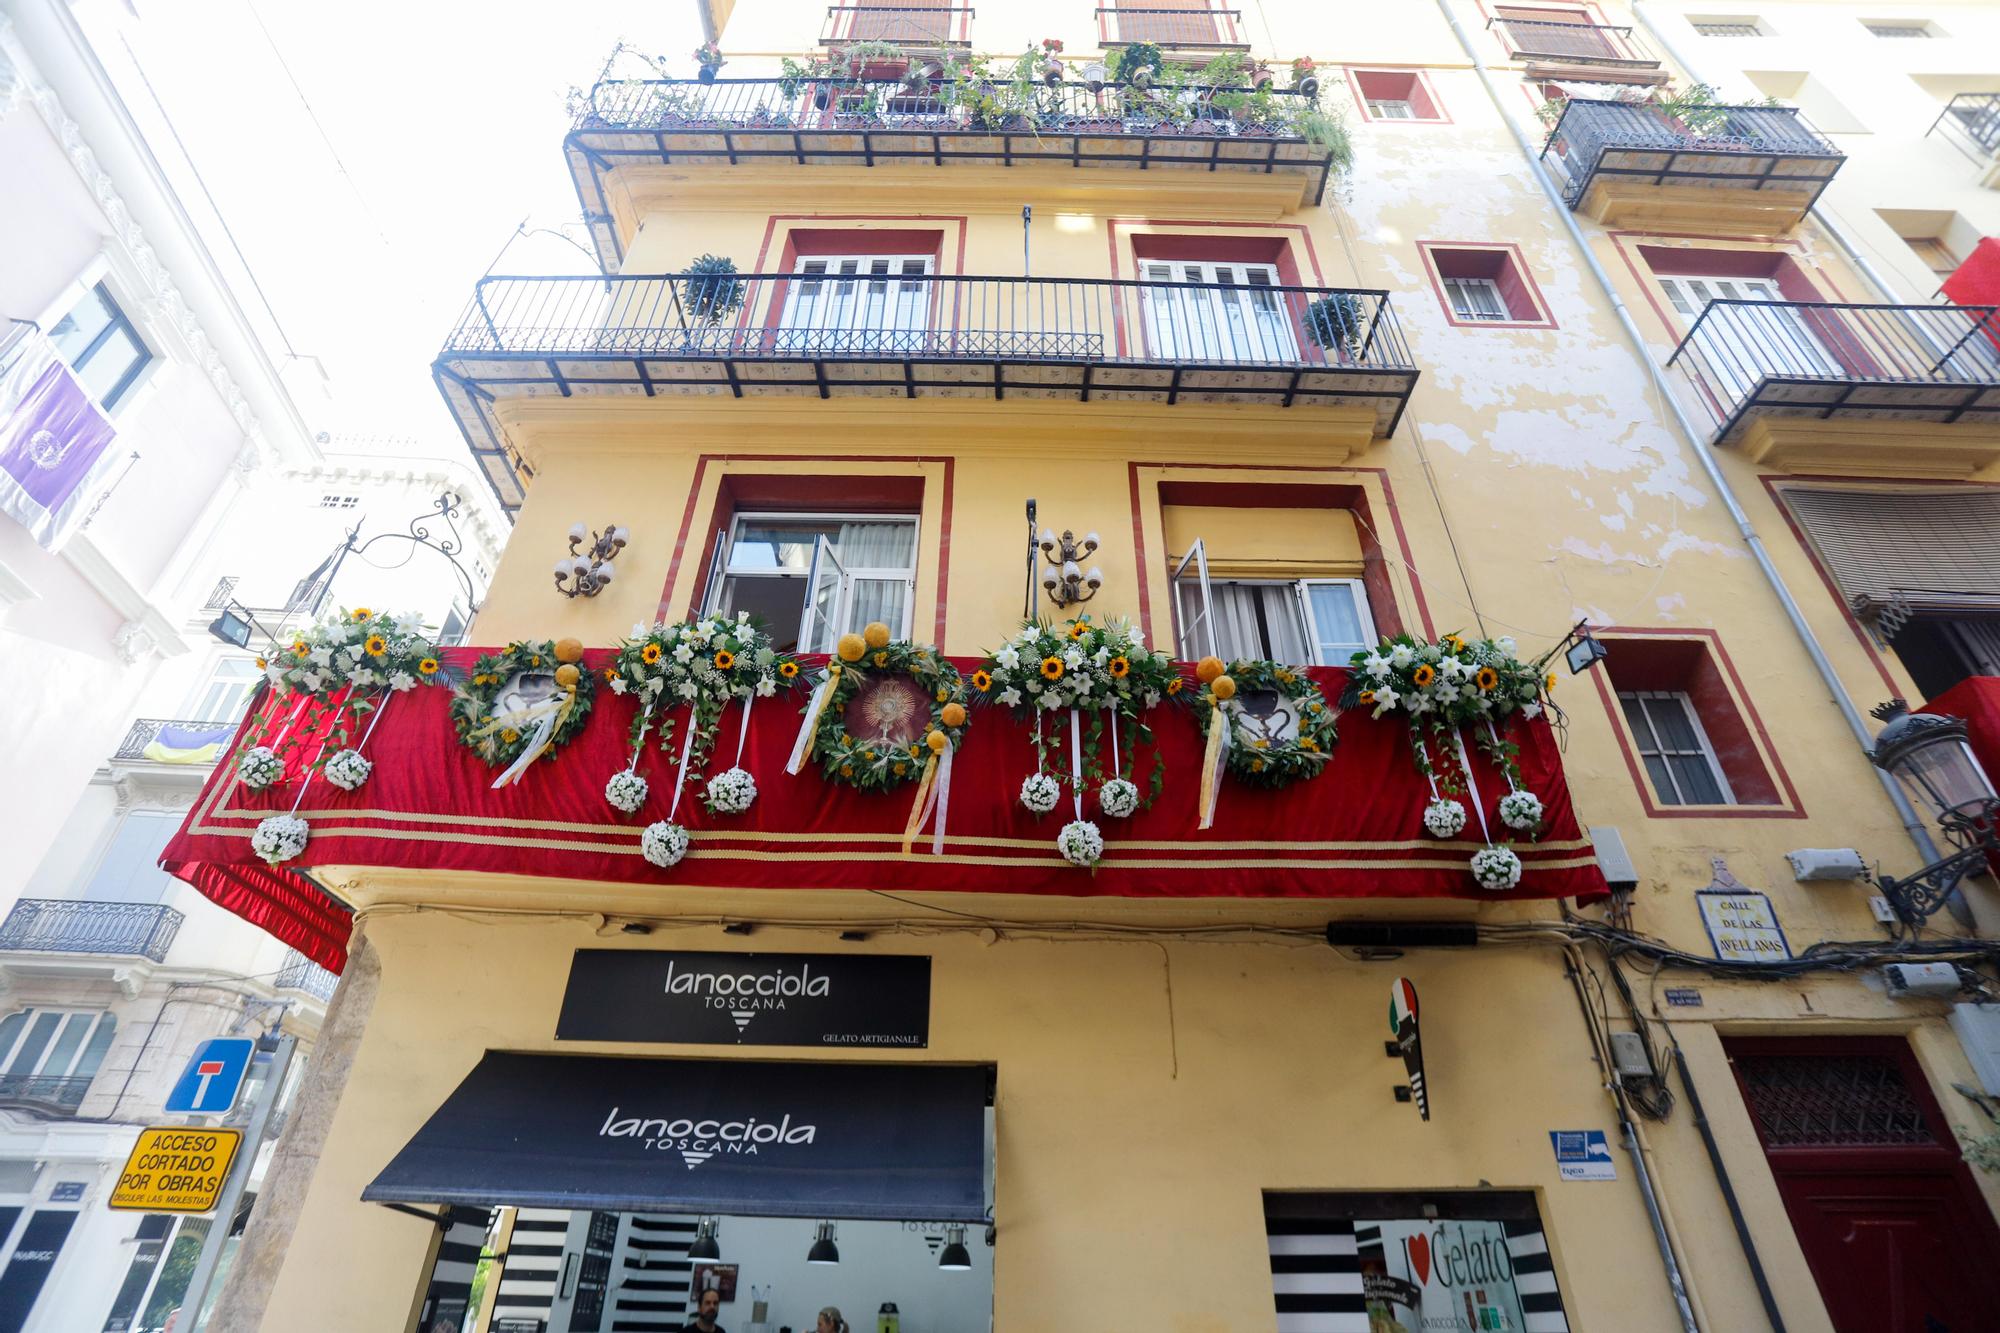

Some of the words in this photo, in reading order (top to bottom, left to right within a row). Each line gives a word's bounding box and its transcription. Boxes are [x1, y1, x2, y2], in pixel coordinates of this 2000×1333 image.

[1720, 901, 1751, 911] CALLE
[1722, 918, 1739, 928] DE
[1742, 919, 1763, 929] LAS
[1719, 938, 1784, 952] AVELLANAS
[663, 959, 831, 998] lanocciola
[703, 996, 787, 1011] TOSCANA
[822, 1033, 858, 1043] GELATO
[859, 1034, 920, 1044] ARTIGIANALE
[598, 1106, 817, 1145] lanocciola
[149, 1135, 217, 1153] ACCESO
[642, 1137, 759, 1156] TOSCANA
[137, 1154, 215, 1172] CORTADO
[120, 1174, 151, 1191] POR
[157, 1175, 218, 1193] OBRAS
[113, 1193, 145, 1202] DISCULPE
[146, 1195, 163, 1203] LAS
[165, 1195, 211, 1206] MOLESTIAS
[1431, 1221, 1512, 1288] Gelato
